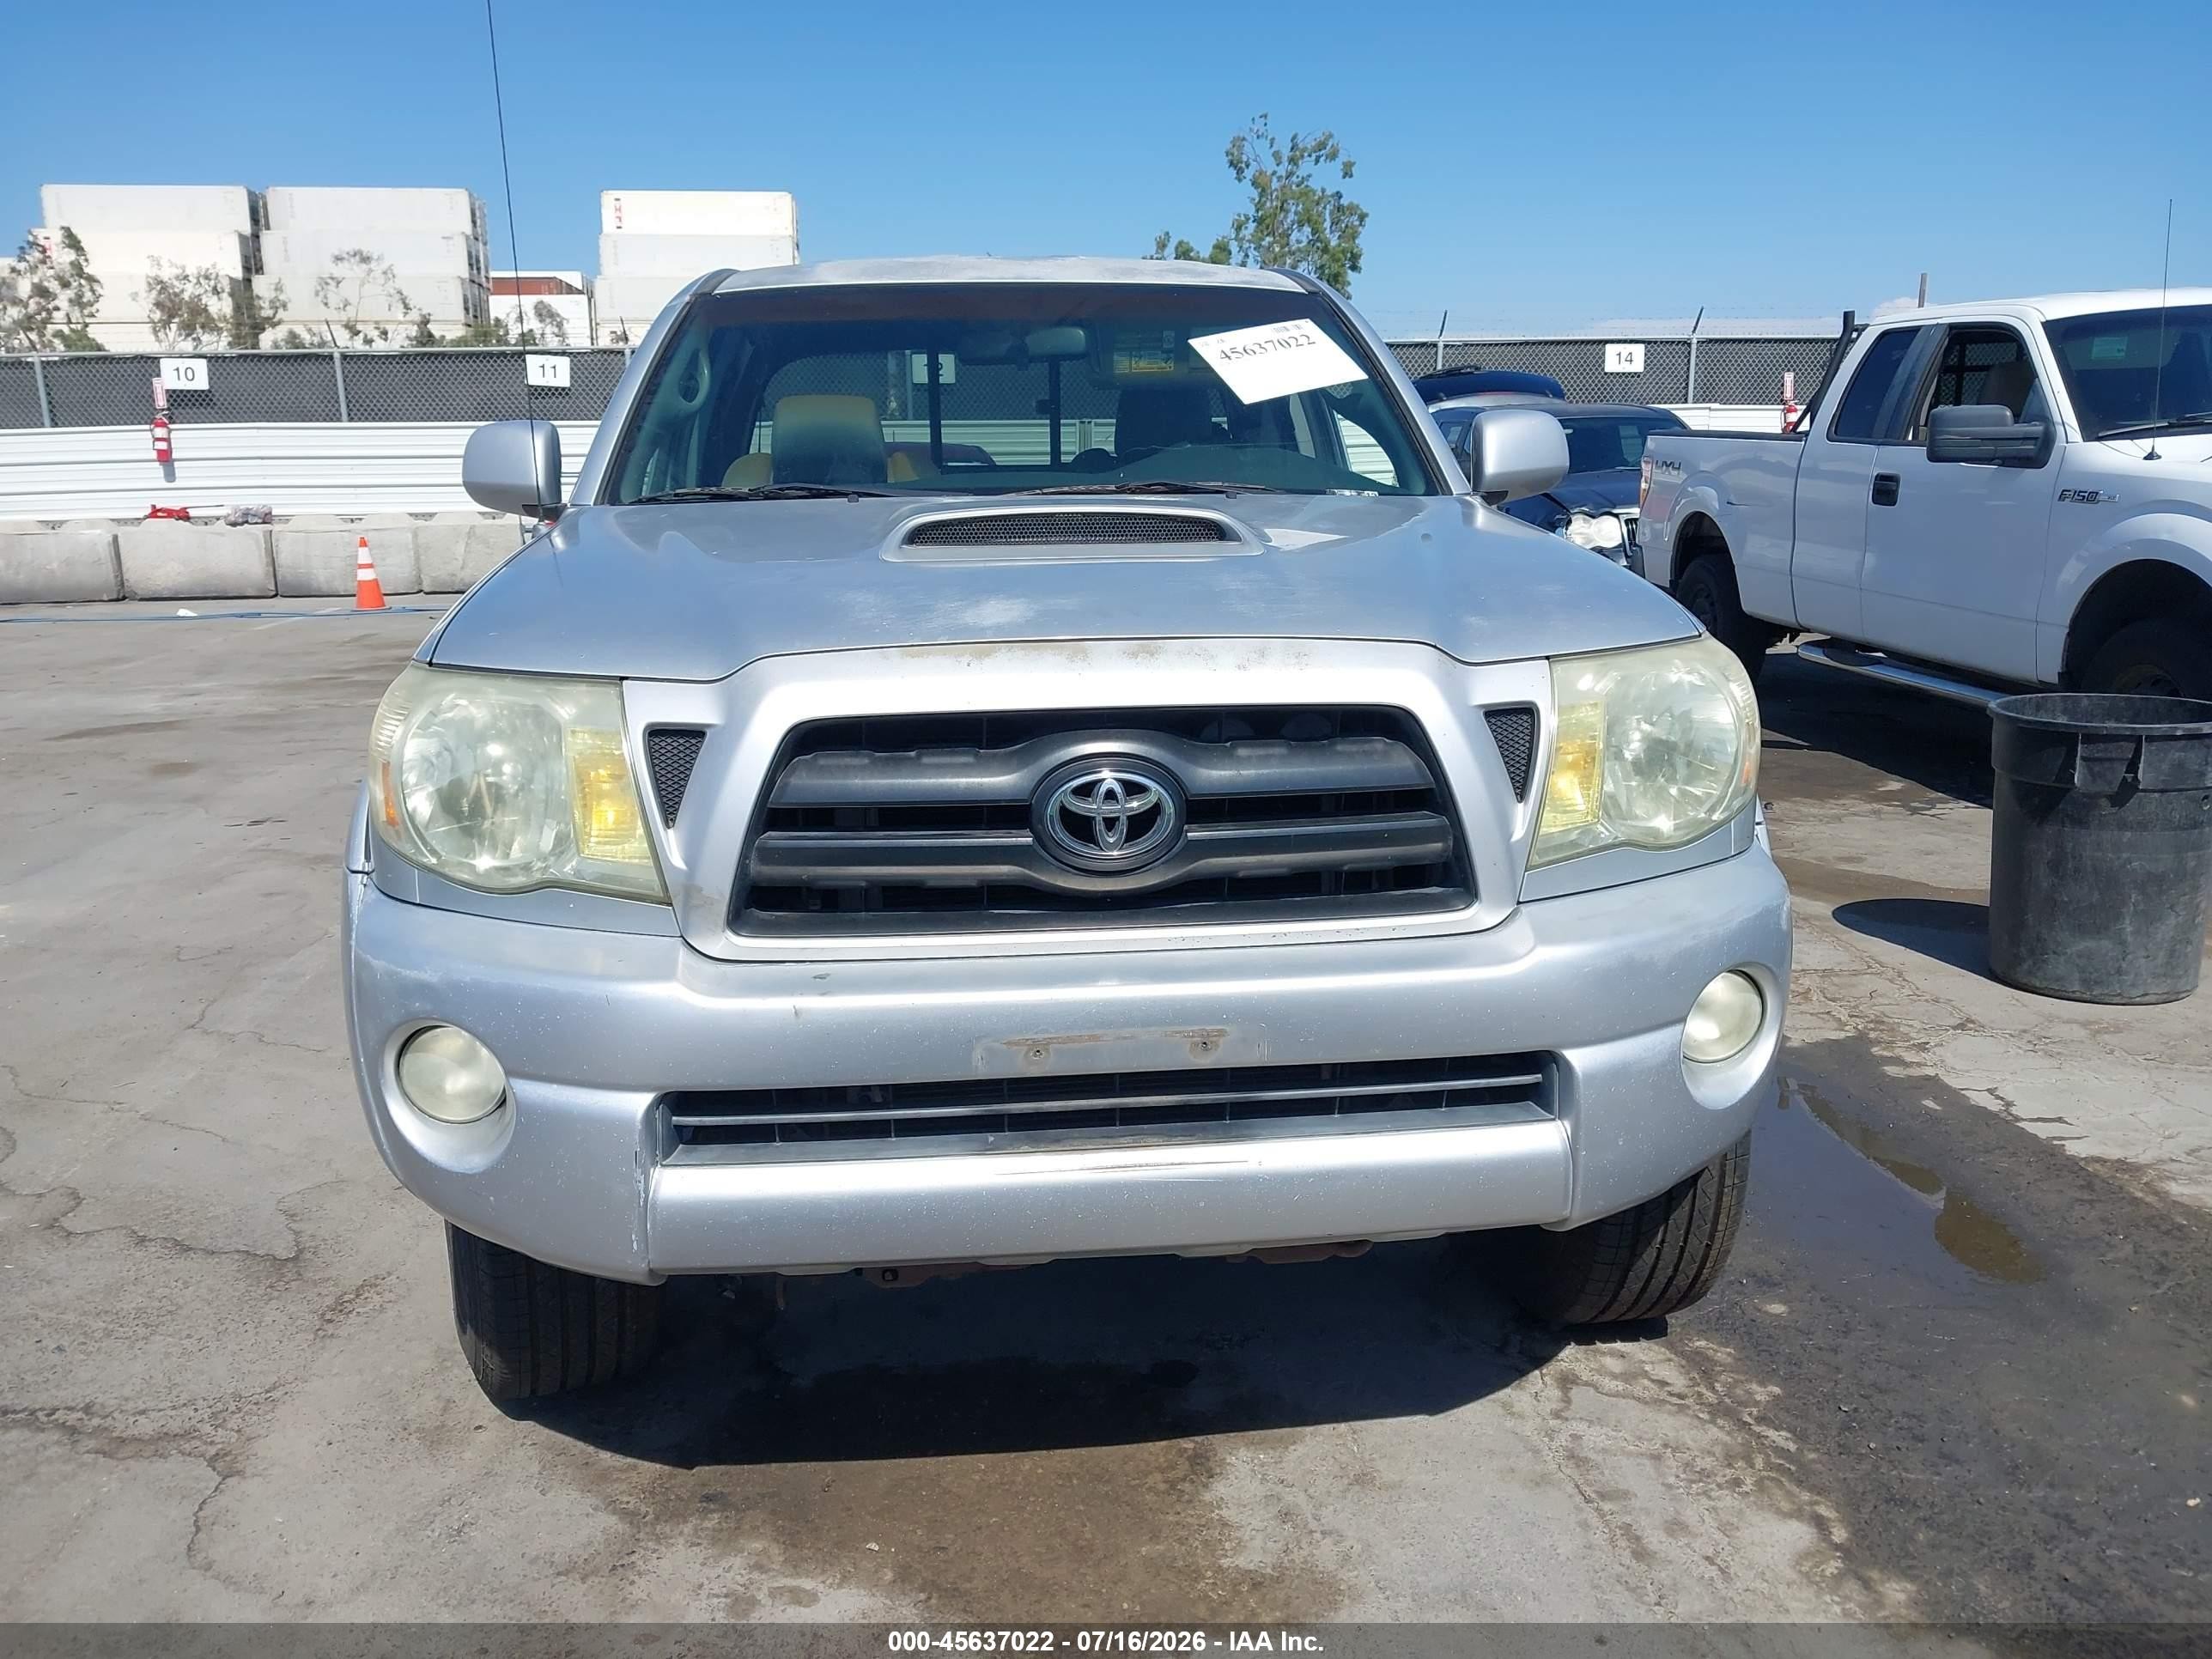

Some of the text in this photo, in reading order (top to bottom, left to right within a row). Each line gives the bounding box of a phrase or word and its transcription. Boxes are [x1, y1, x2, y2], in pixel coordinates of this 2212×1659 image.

[1220, 334, 1316, 360] 45637022
[1615, 351, 1634, 365] 14
[173, 367, 196, 382] 10
[538, 363, 556, 379] 11
